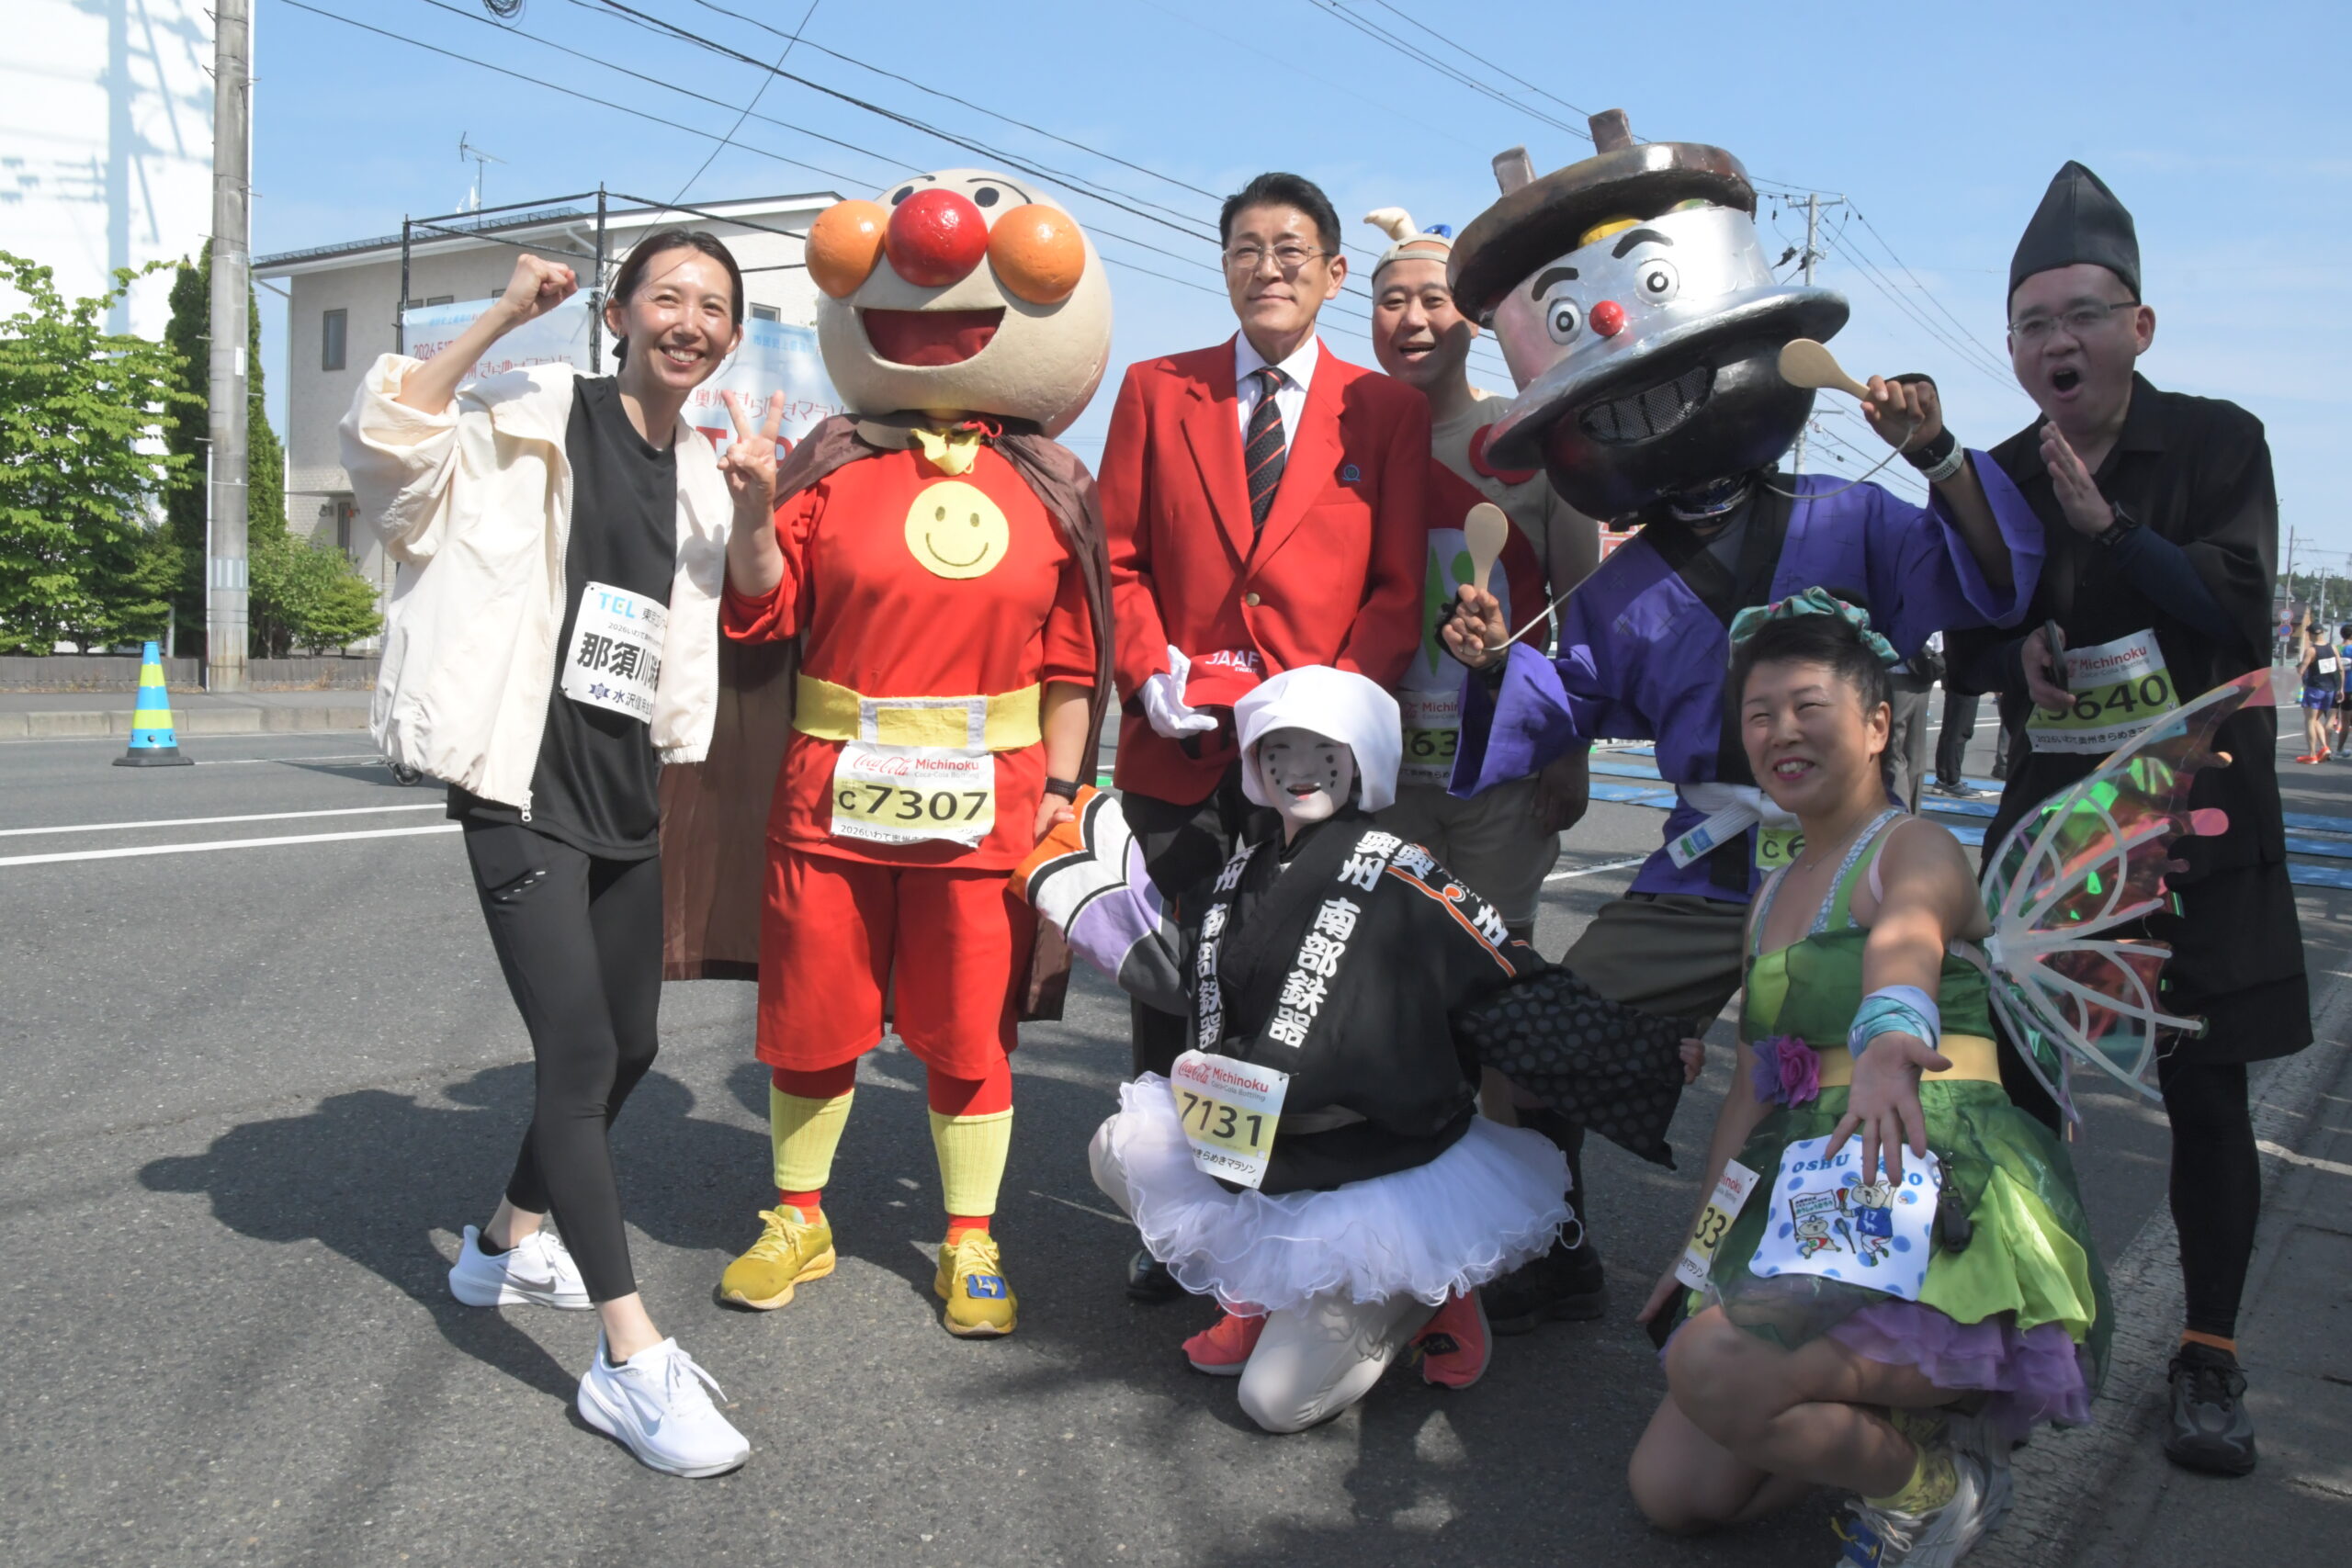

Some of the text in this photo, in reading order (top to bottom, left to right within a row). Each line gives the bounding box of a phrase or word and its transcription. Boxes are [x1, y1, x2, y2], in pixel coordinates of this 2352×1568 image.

[599, 592, 636, 619] TEL
[1205, 650, 1260, 667] JAAF
[2079, 646, 2147, 671] Michinoku
[853, 751, 979, 776] Coca-Cola Michinoku
[1472, 903, 1510, 947] 州
[1269, 830, 1402, 1048] 奥州 南部鉄器
[1213, 1067, 1269, 1093] Michinoku
[1238, 1086, 1266, 1102] Bottling
[1182, 1092, 1262, 1146] 7131
[1792, 1154, 1850, 1174] OSHU
[1864, 1212, 1877, 1221] 17
